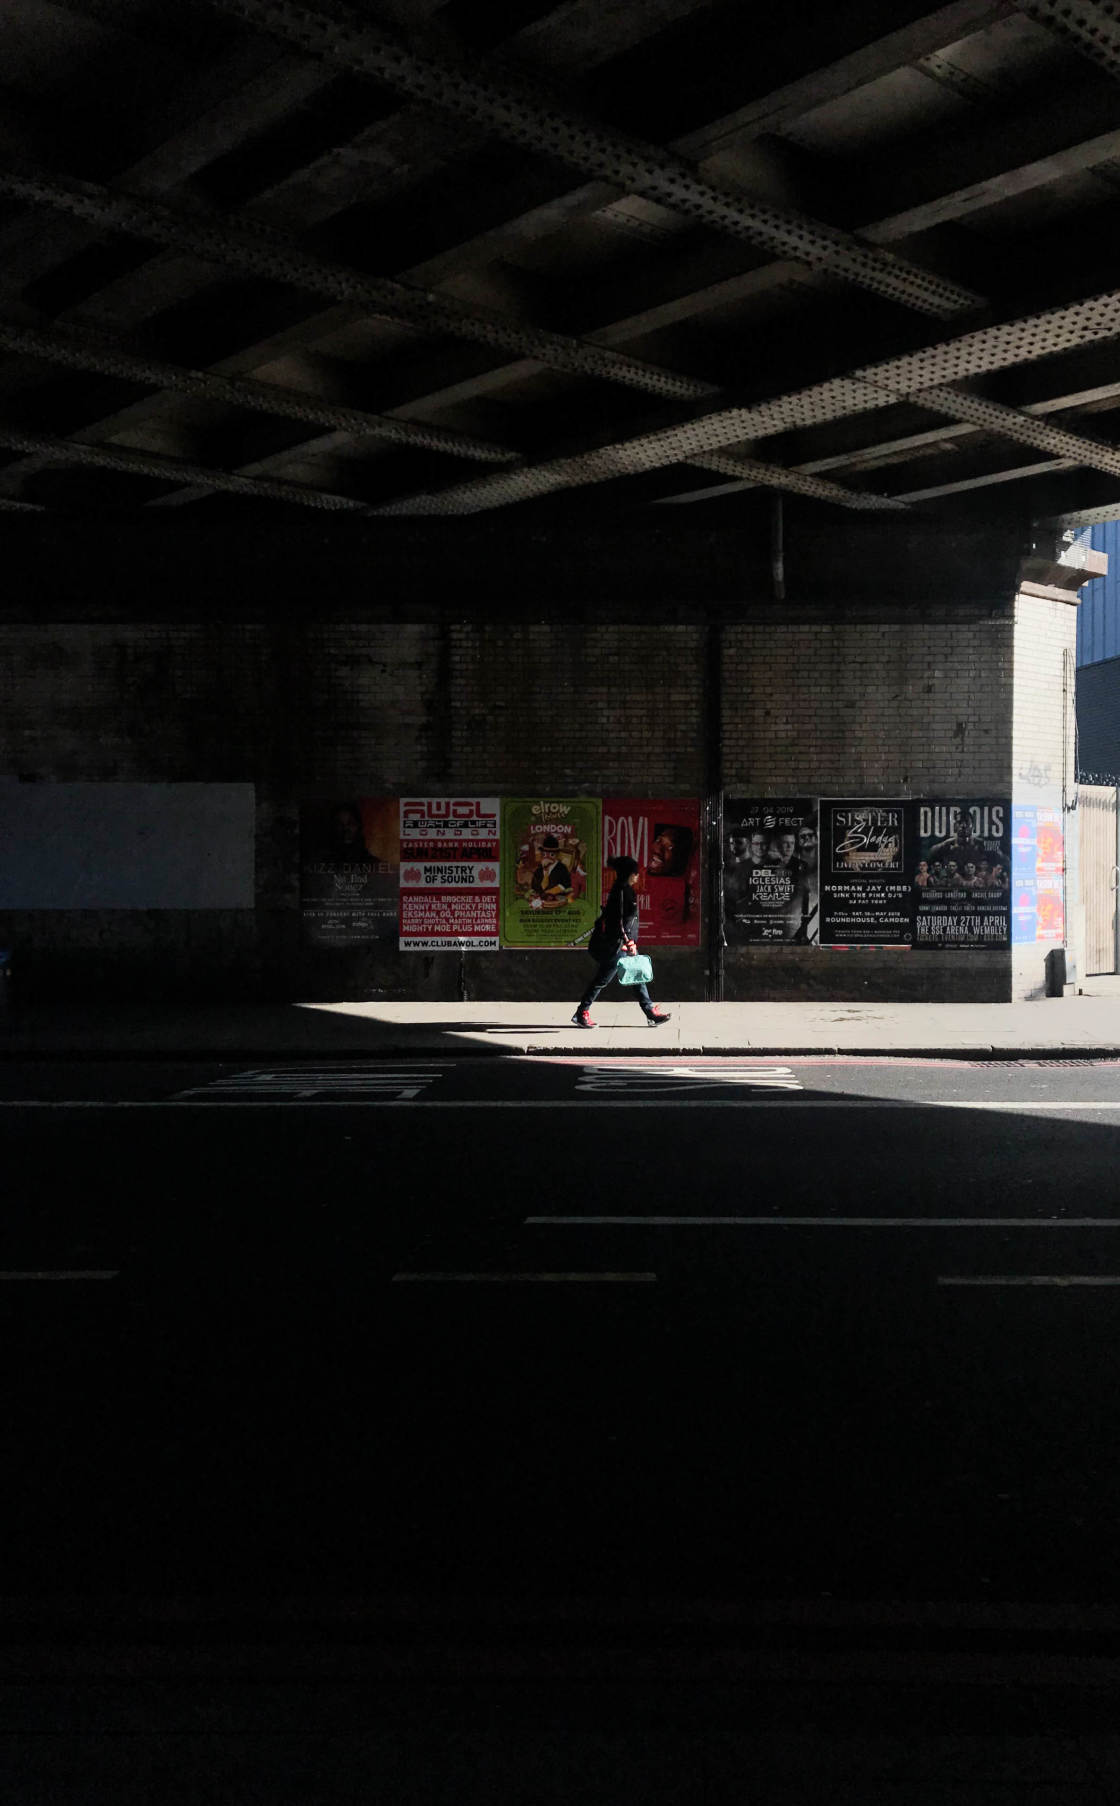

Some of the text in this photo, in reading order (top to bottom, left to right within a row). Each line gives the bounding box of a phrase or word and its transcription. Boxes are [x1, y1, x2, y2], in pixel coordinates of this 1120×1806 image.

[403, 801, 497, 819] AWOL
[531, 801, 572, 815] elrow
[836, 811, 899, 827] SISTER
[468, 820, 496, 828] LIFE
[403, 829, 497, 837] LONDON
[530, 824, 572, 834] LONDON
[835, 821, 896, 856] Sledge
[461, 847, 496, 859] APRIL
[424, 865, 474, 875] MINISTRY
[425, 875, 475, 884] OF SOUND
[749, 877, 791, 885] IGLESIAS
[756, 884, 795, 893] JACK SWIFT
[402, 903, 430, 911] KENNY
[451, 903, 476, 911] MICKY
[478, 903, 497, 911] FINN
[454, 910, 497, 918] PHANTASY
[916, 915, 1007, 927] SATURDAY 27TH APRIL
[402, 924, 497, 932] MIGHTY MOE PLUS MORE
[916, 926, 929, 936] THE
[931, 926, 944, 936] SSE
[973, 926, 1008, 936] WEMBLEY
[403, 940, 497, 948] WWW.CLUBAWOL.COM
